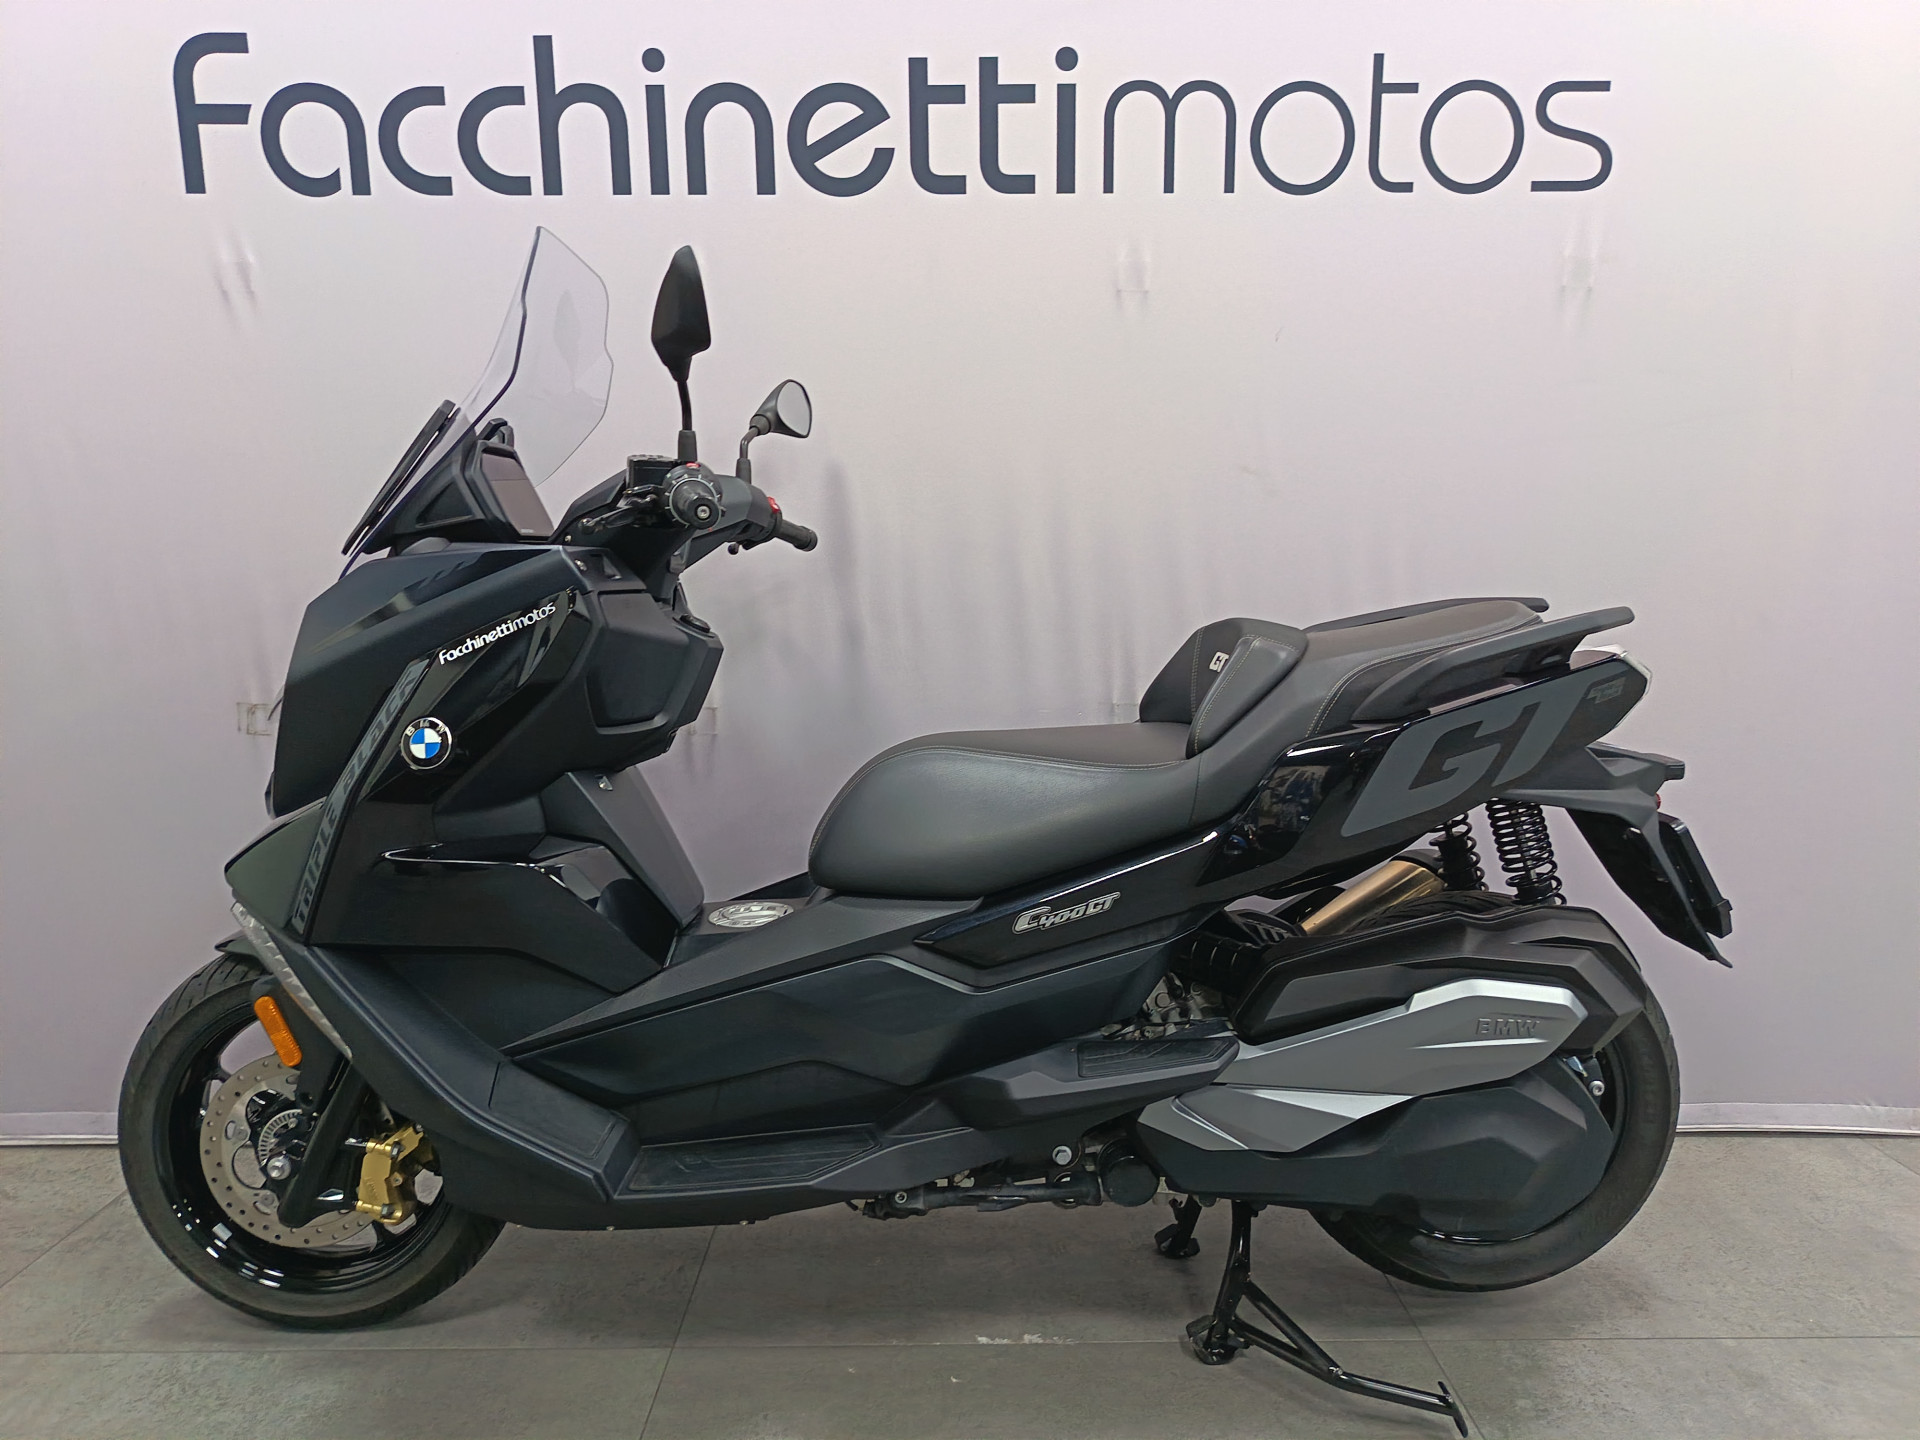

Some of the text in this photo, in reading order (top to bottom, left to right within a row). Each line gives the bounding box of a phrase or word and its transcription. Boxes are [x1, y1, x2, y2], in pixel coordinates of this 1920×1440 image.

[343, 673, 417, 792] BLACK
[405, 719, 447, 737] BMW
[1340, 658, 1638, 838] GT
[1475, 1018, 1540, 1037] BMW
